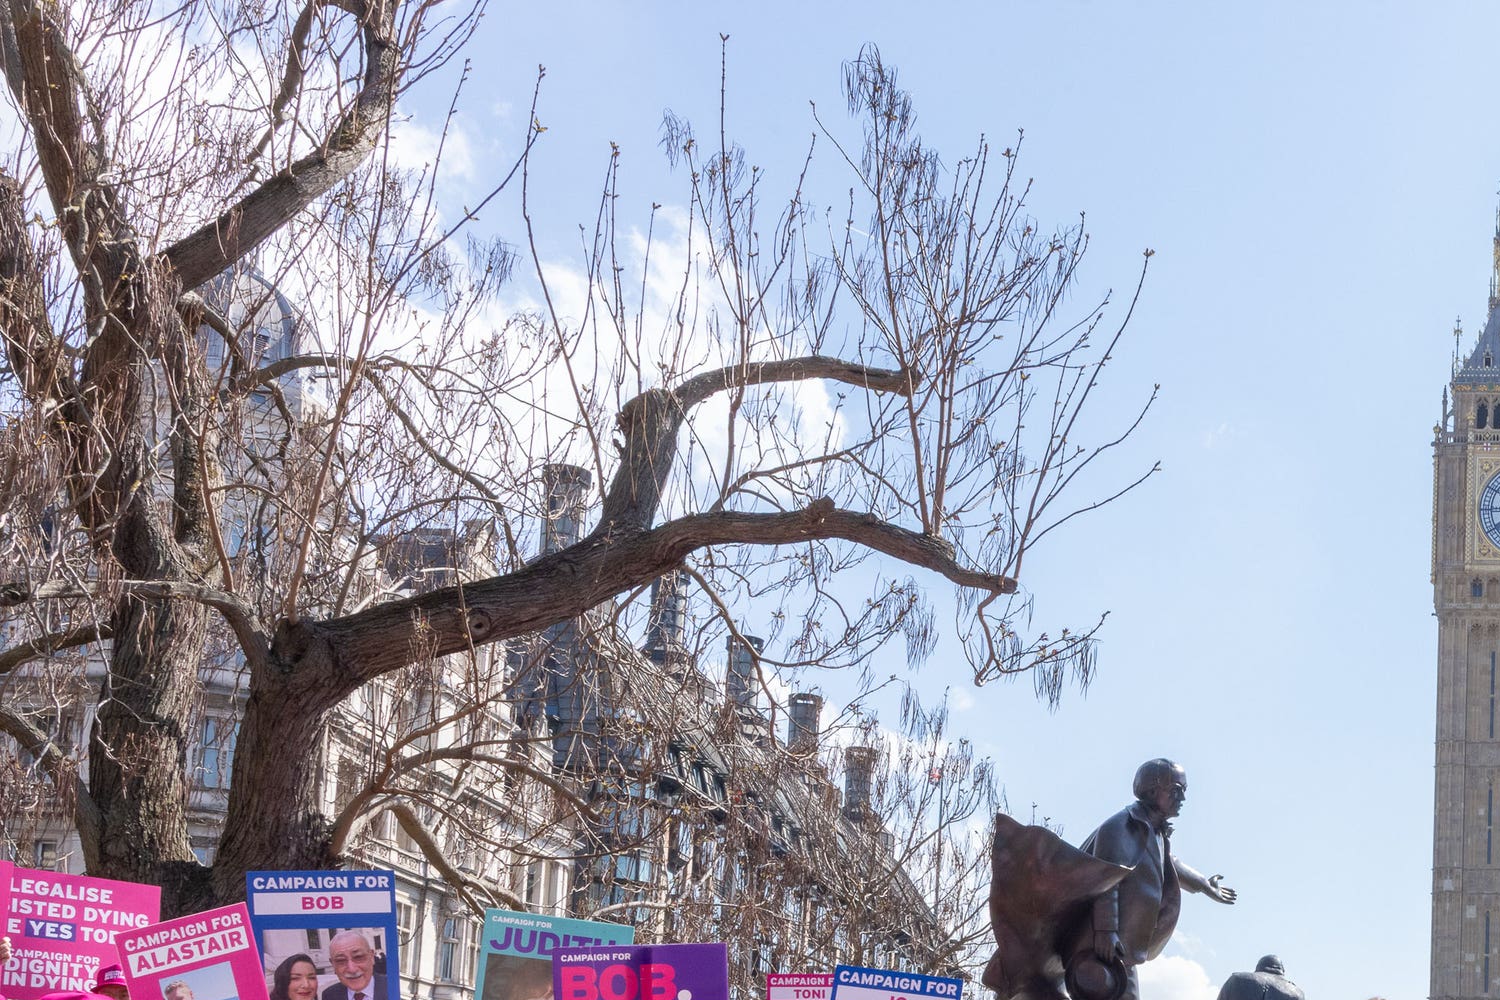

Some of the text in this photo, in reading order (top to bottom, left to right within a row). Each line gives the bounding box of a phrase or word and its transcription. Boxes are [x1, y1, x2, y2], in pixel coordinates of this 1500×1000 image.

[253, 875, 389, 890] CAMPAIGN FOR
[10, 877, 112, 904] LEGALISE
[302, 896, 344, 910] BOB
[492, 915, 552, 928] CAMPAIGN FOR
[124, 912, 242, 952] CAMPAIGN FOR
[136, 930, 244, 972] ALASTAIR
[561, 954, 610, 962] CAMPAIGN
[4, 958, 99, 979] DIGNITY
[770, 978, 826, 986] CAMPAIGN
[839, 970, 958, 996] CAMPAIGN FOR
[794, 989, 826, 1000] TONI
